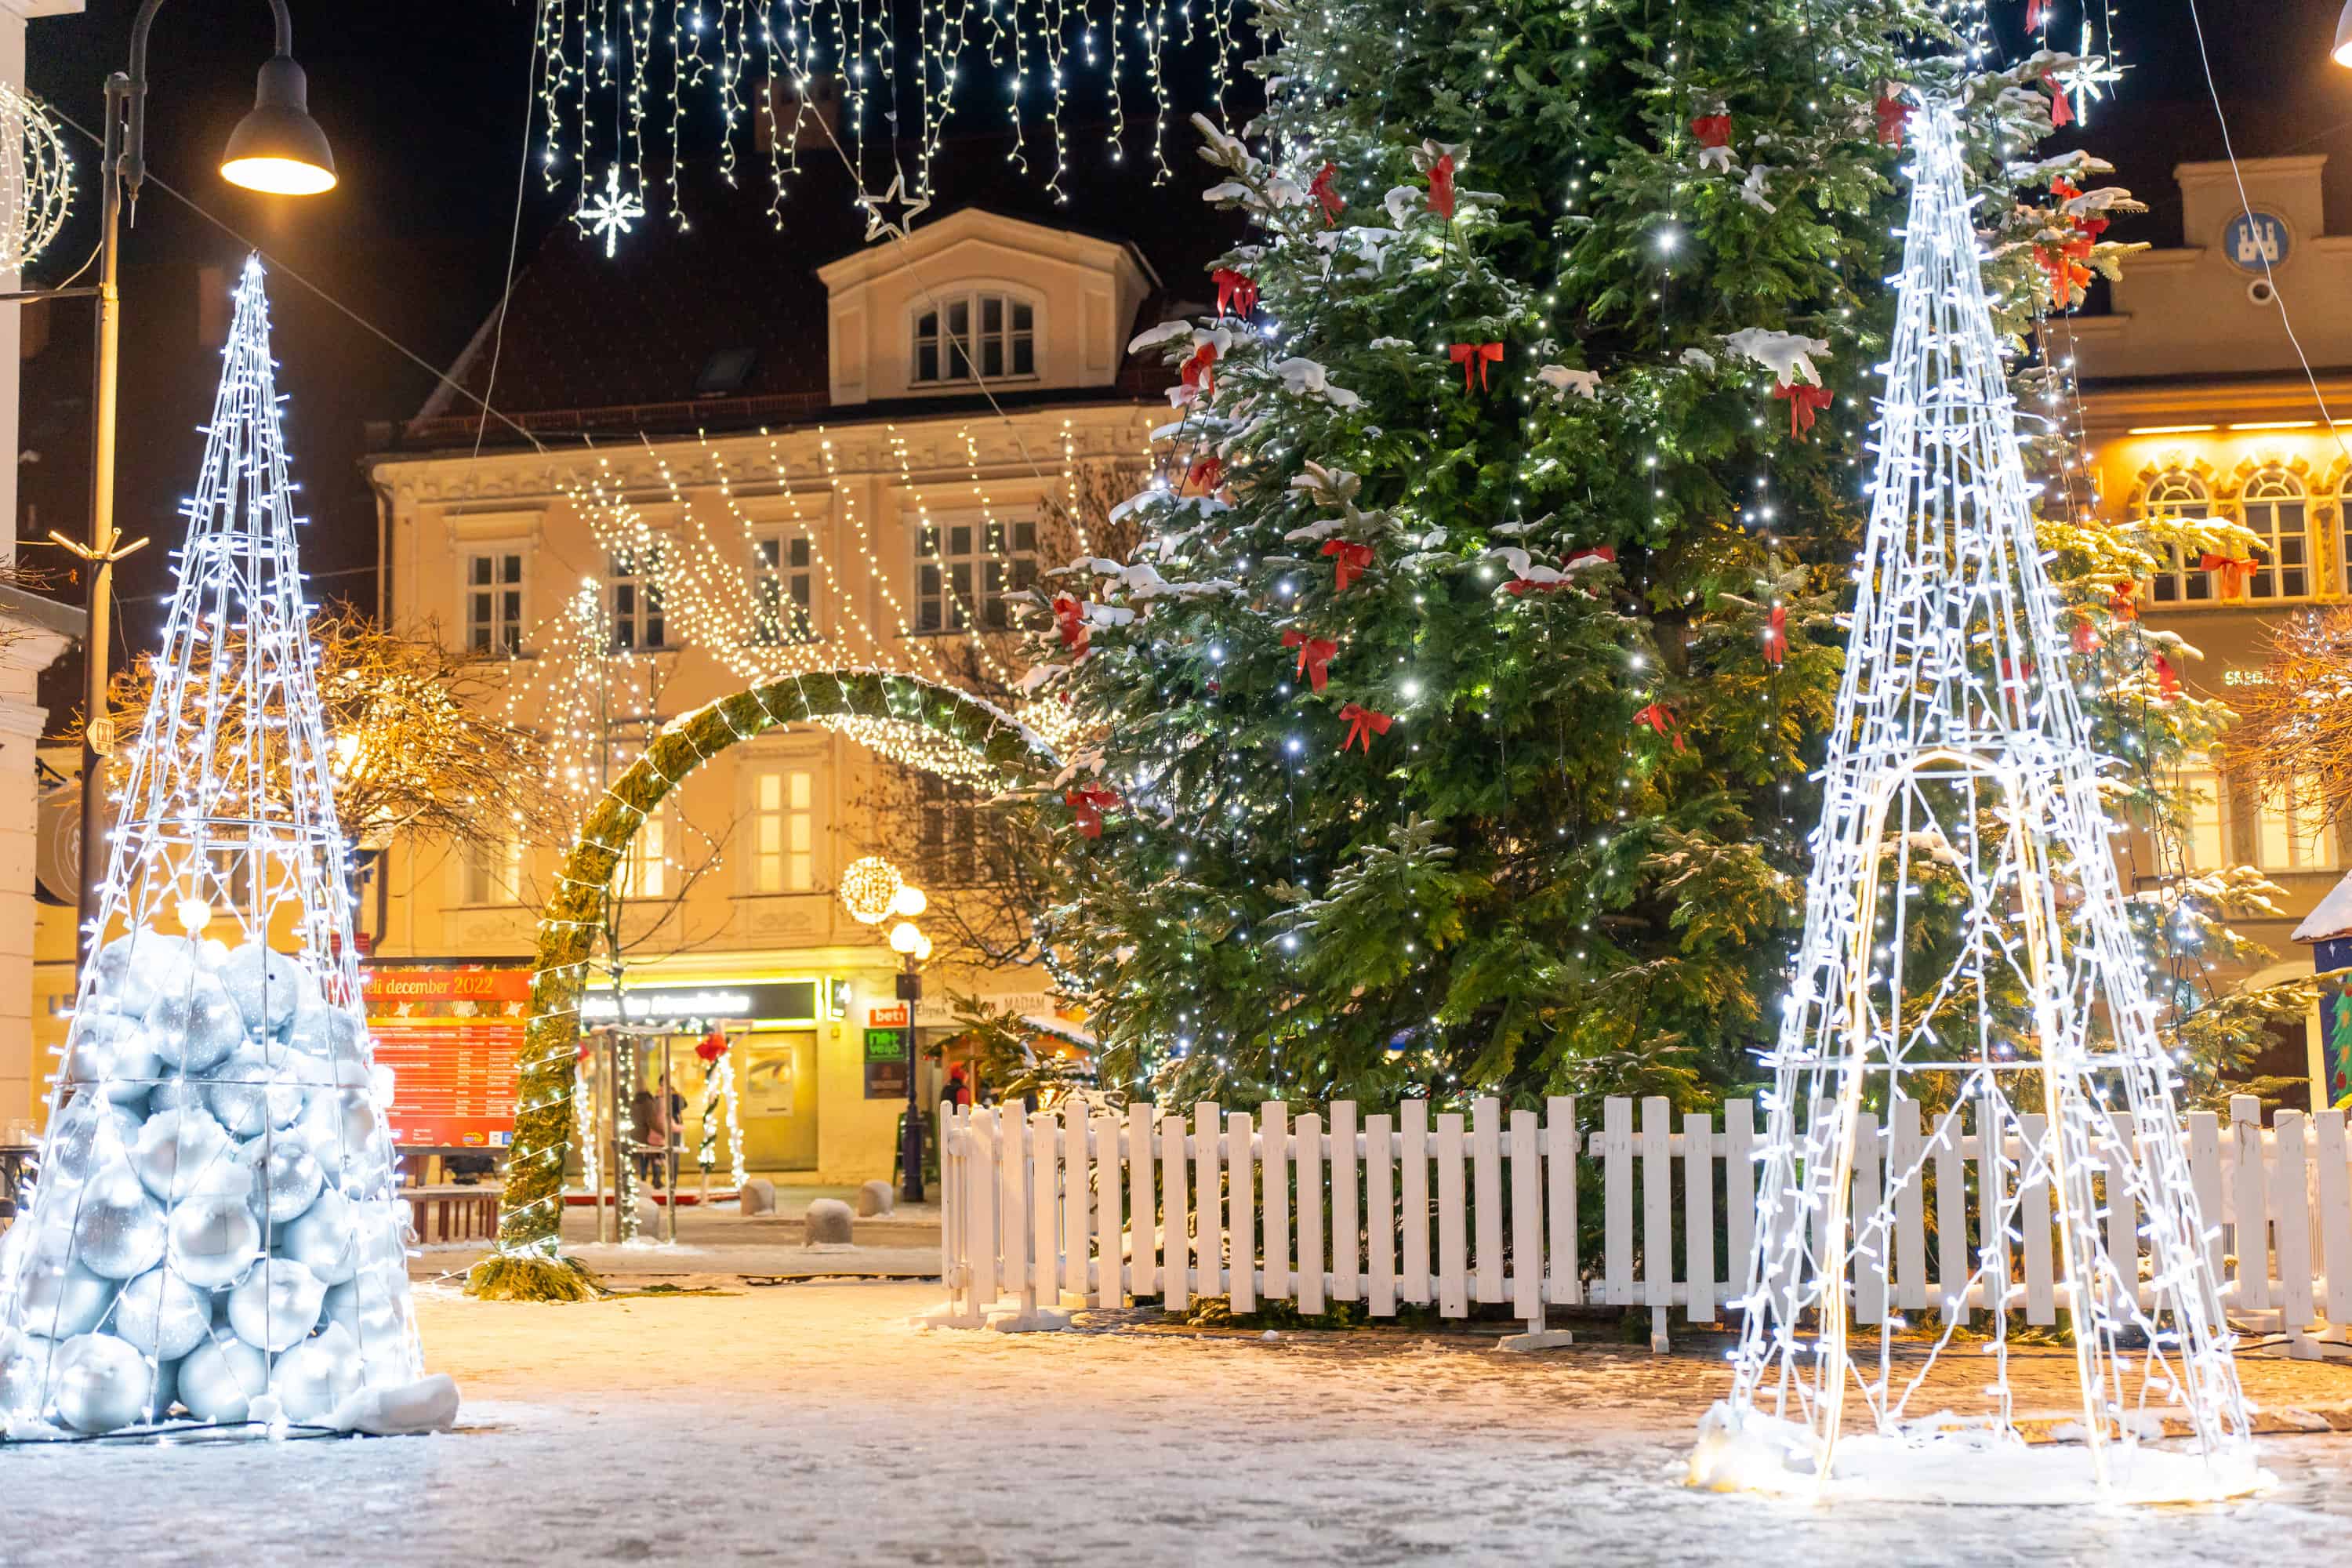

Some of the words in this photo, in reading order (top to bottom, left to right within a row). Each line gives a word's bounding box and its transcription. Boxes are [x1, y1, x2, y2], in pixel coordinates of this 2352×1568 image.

[386, 978, 450, 995] december
[453, 976, 493, 994] 2022
[1004, 997, 1045, 1011] MADAM
